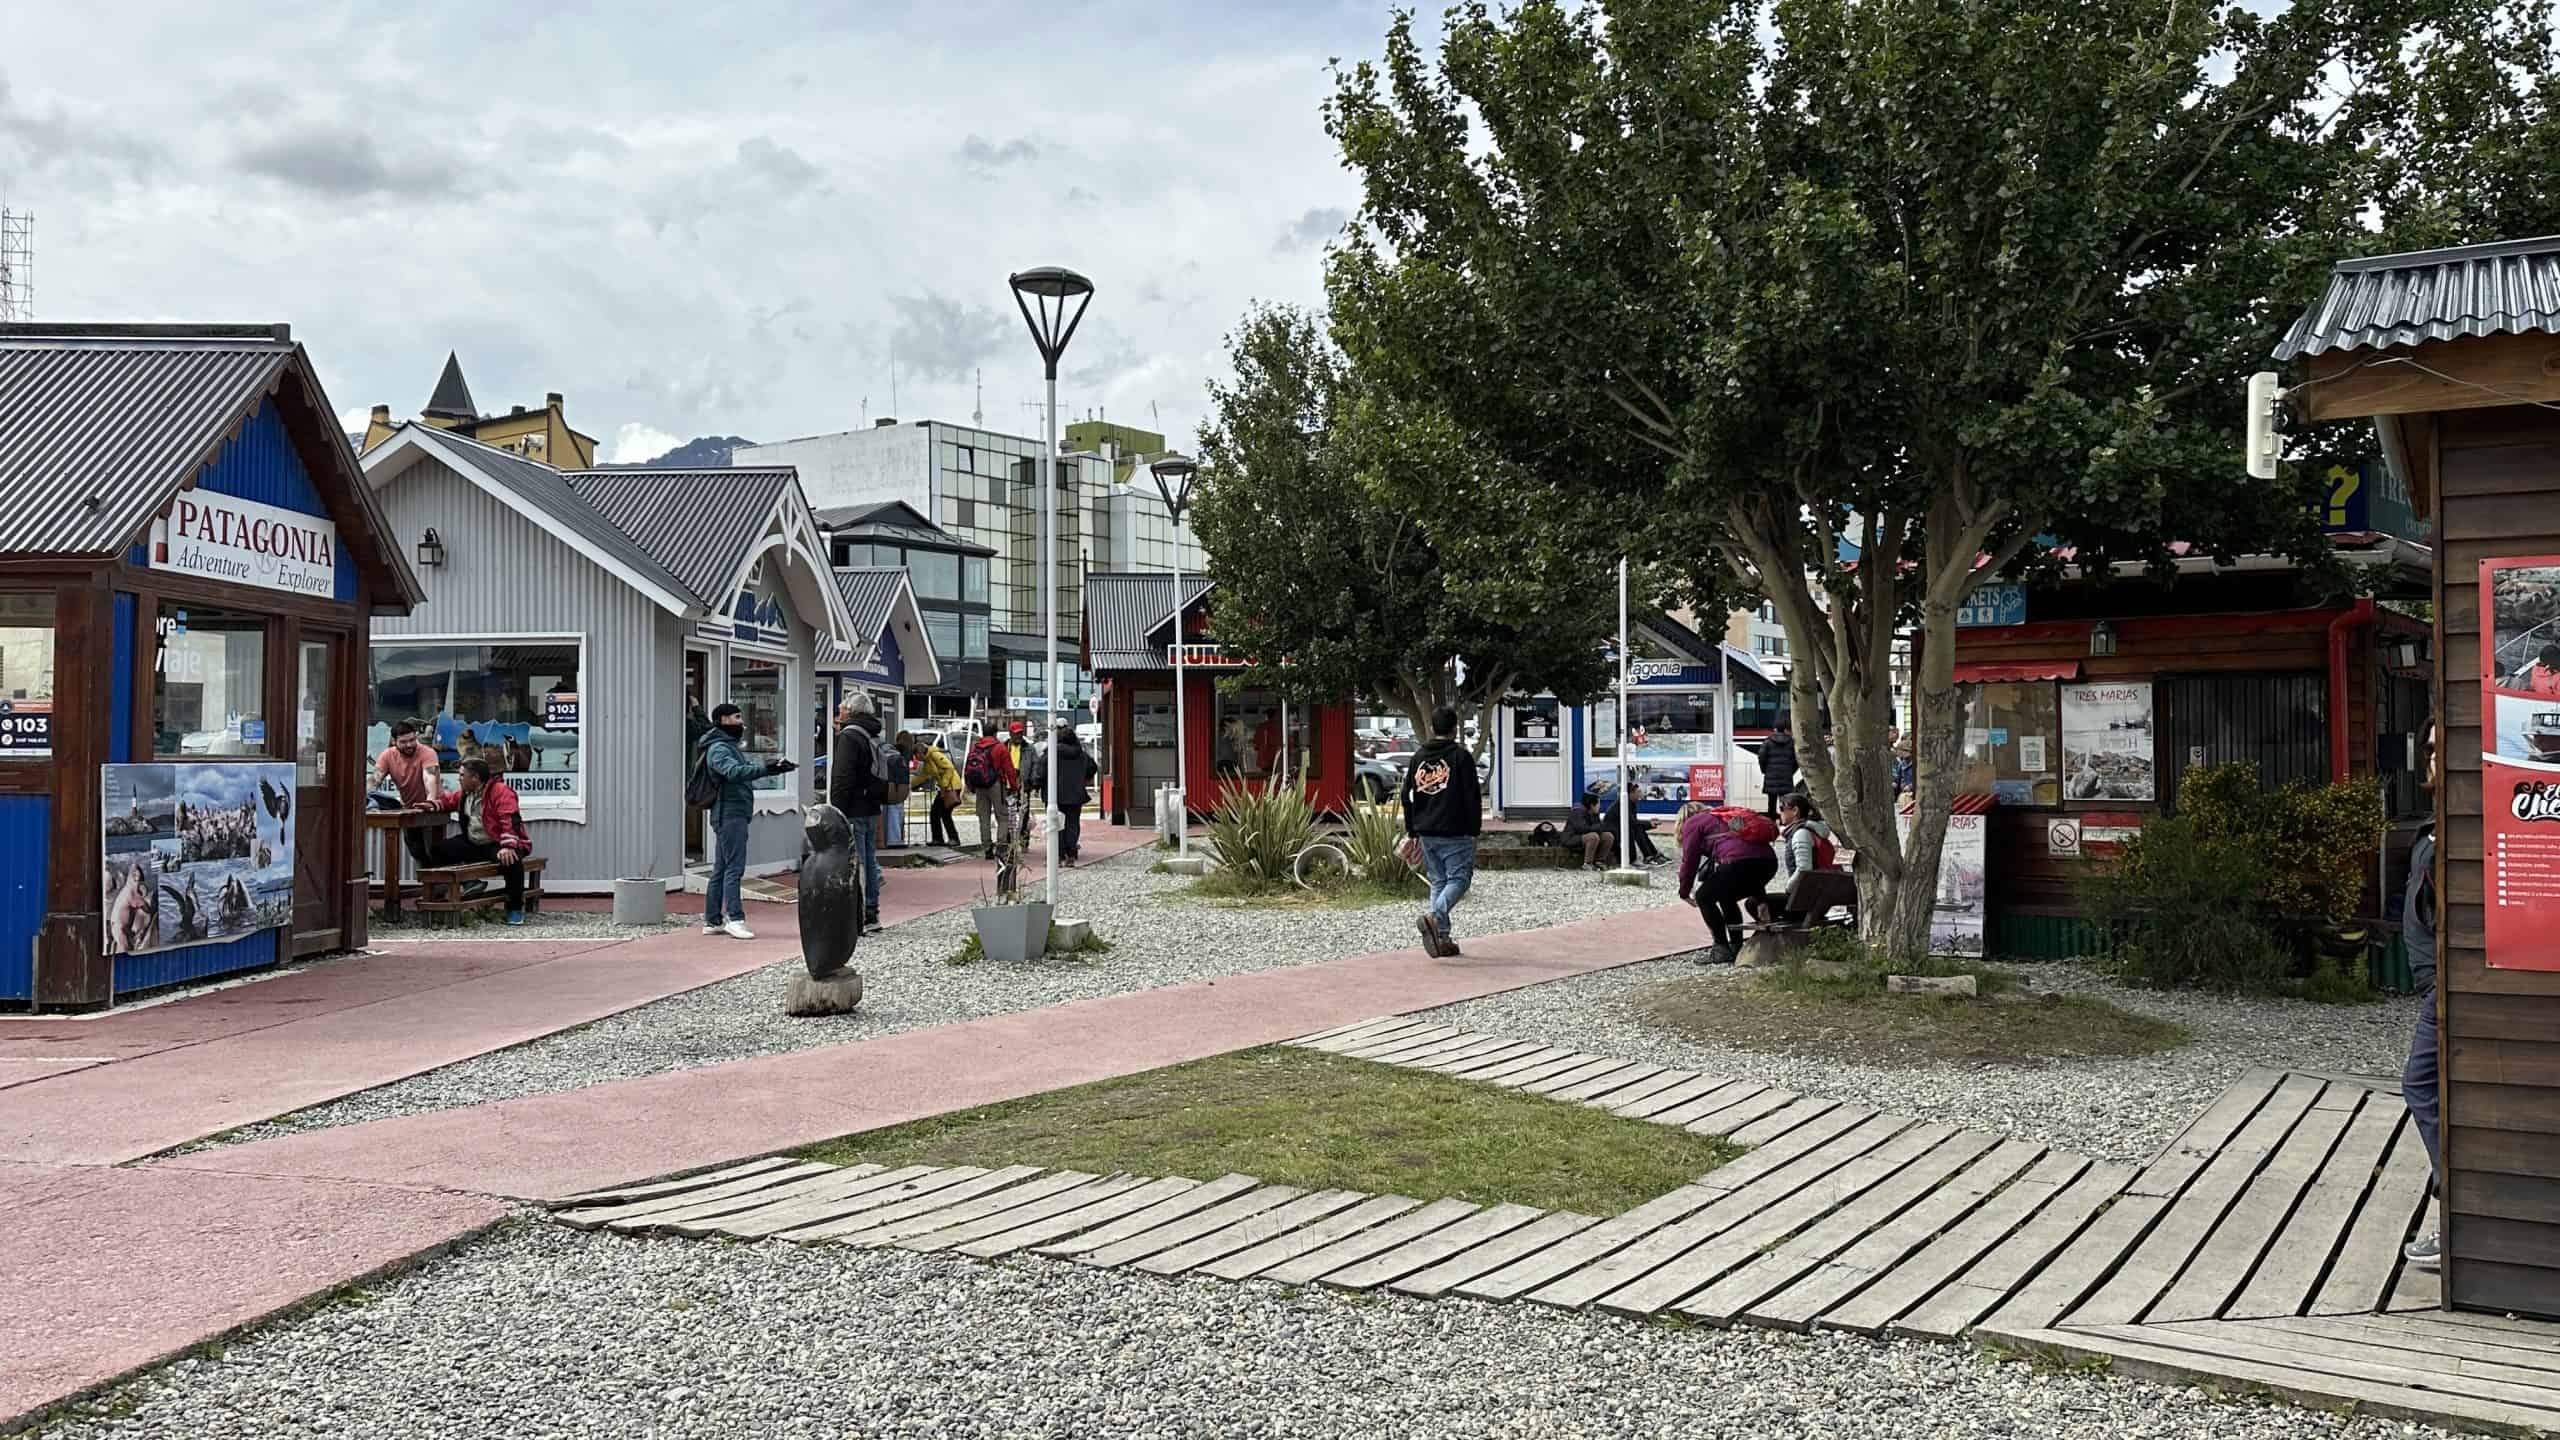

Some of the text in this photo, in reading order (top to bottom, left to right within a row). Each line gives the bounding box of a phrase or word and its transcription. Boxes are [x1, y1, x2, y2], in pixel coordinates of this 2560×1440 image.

[177, 500, 333, 567] PATAGONIA
[177, 543, 331, 593] Adventure Explorer
[2073, 688, 2139, 701] TRES MARIAS
[556, 704, 576, 714] 103
[15, 718, 48, 733] 103
[506, 777, 571, 791] URSIONES
[1951, 817, 1977, 829] RIAS
